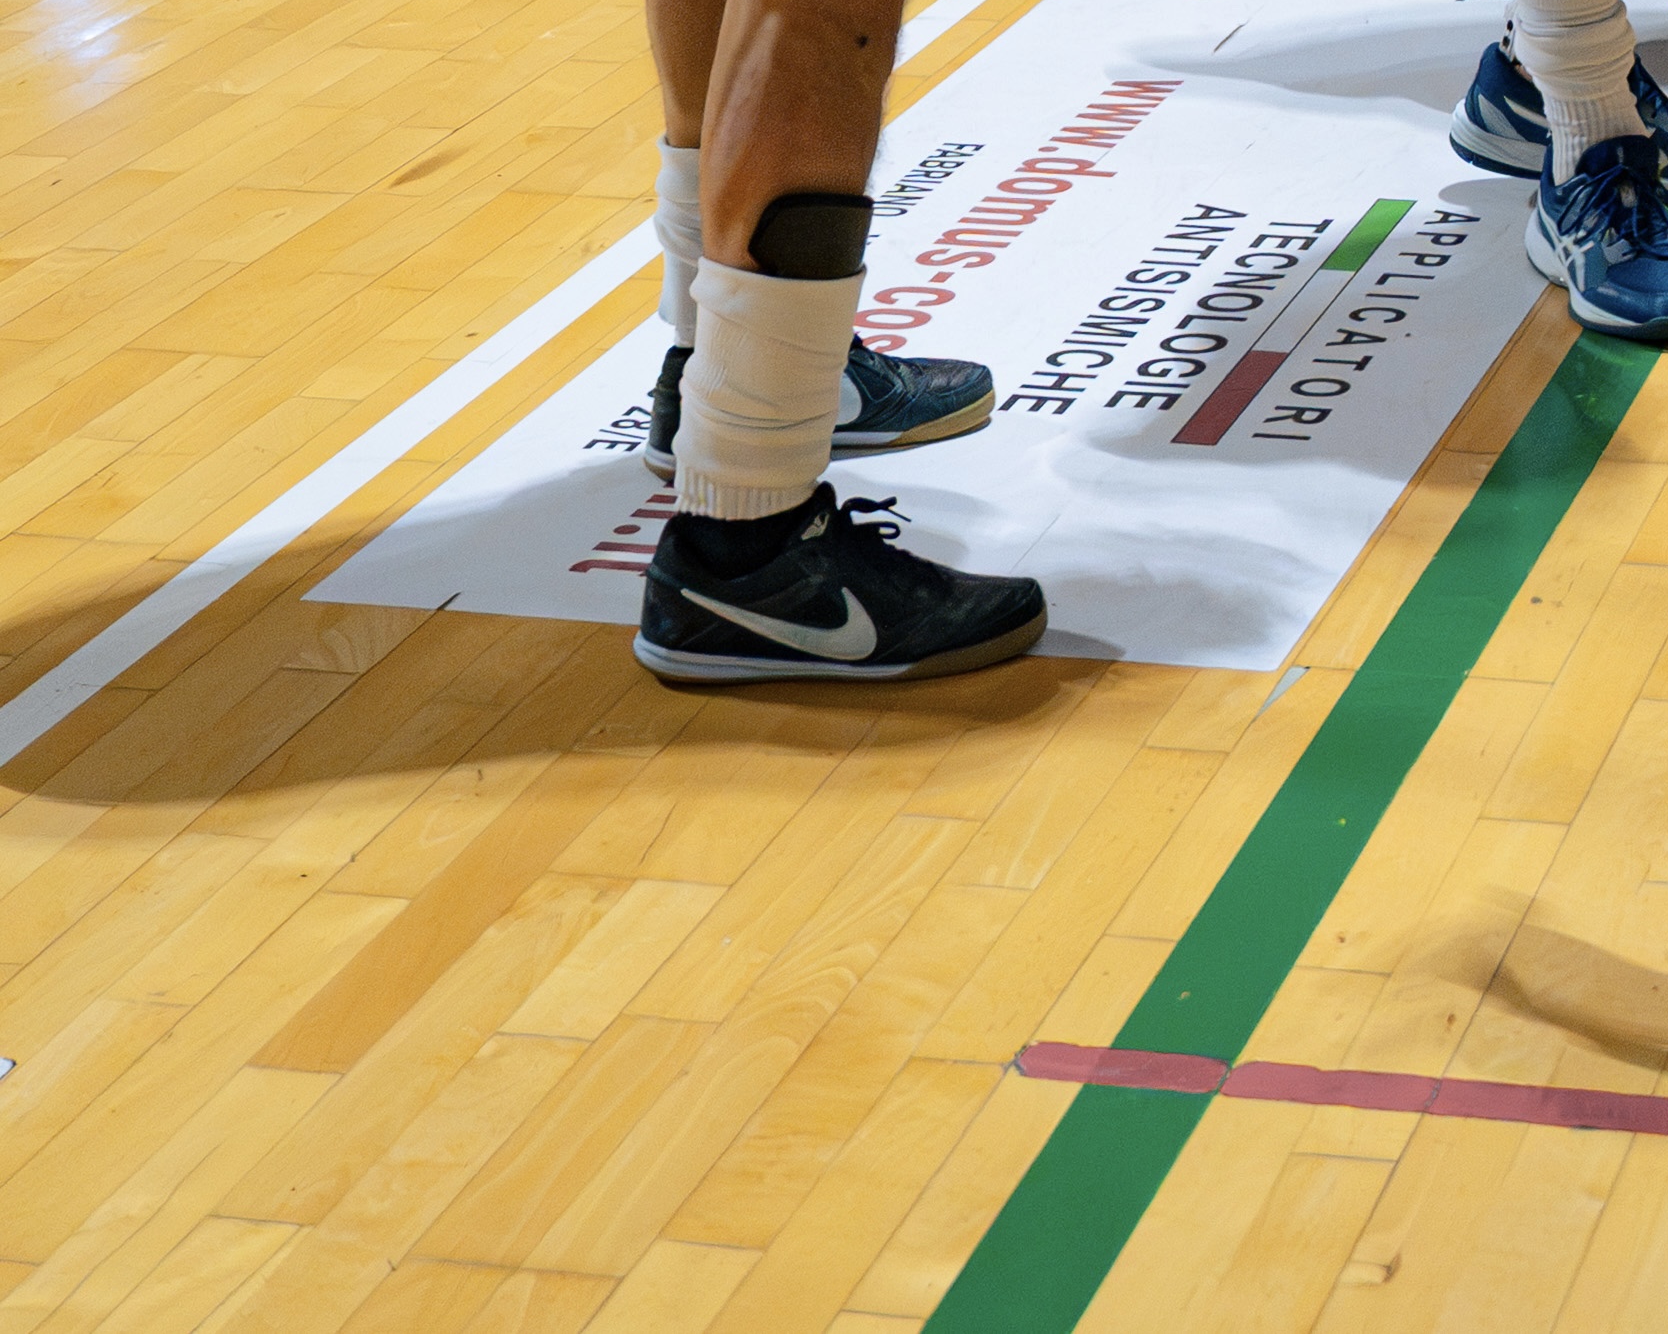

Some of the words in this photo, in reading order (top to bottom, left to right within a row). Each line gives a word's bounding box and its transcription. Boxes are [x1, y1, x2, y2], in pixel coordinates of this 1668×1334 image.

[875, 142, 985, 218] FABRIANO
[997, 203, 1248, 416] ANTISISMICHE
[1103, 218, 1334, 412] TECNOLOGIE
[1252, 209, 1481, 442] APPLICATORI
